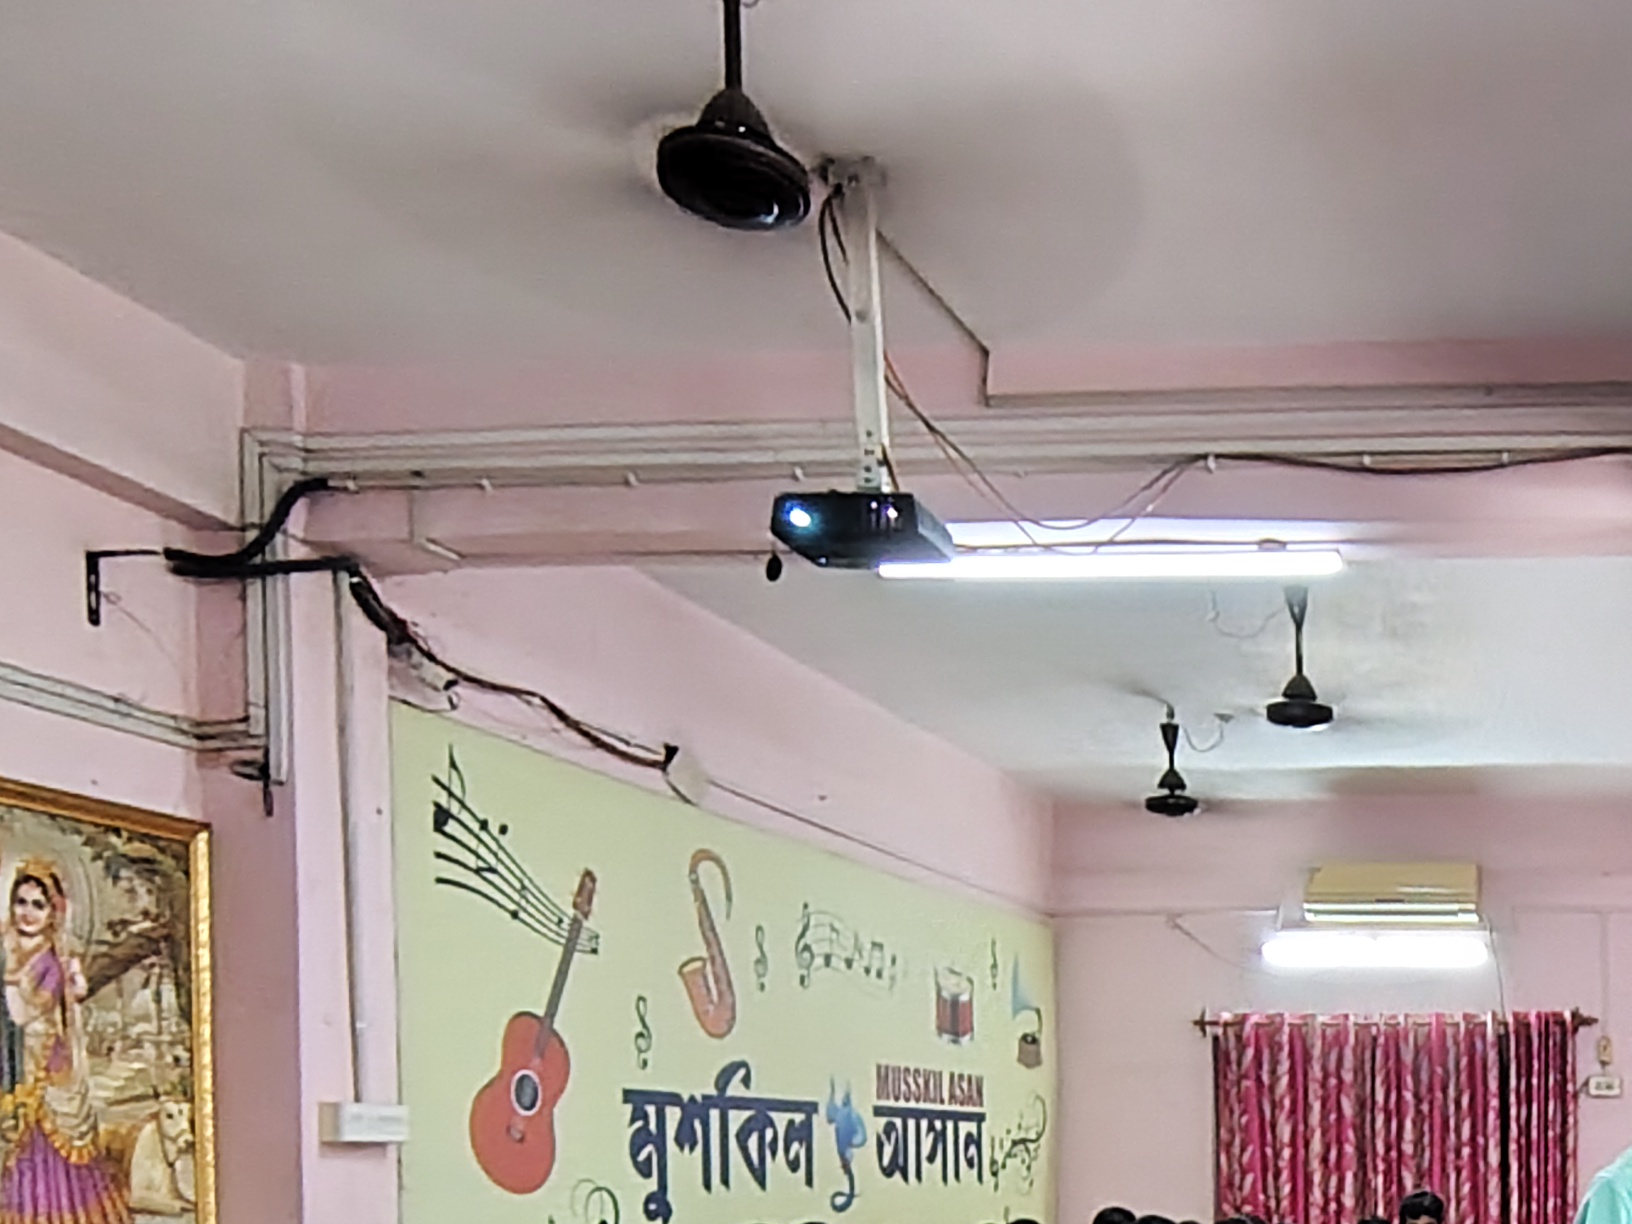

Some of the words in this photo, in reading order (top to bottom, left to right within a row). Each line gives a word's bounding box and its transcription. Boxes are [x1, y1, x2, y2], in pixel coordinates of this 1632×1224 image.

[876, 1063, 945, 1105] MUSSKIL
[948, 1071, 984, 1108] ASAN
[872, 1105, 987, 1187] আসান
